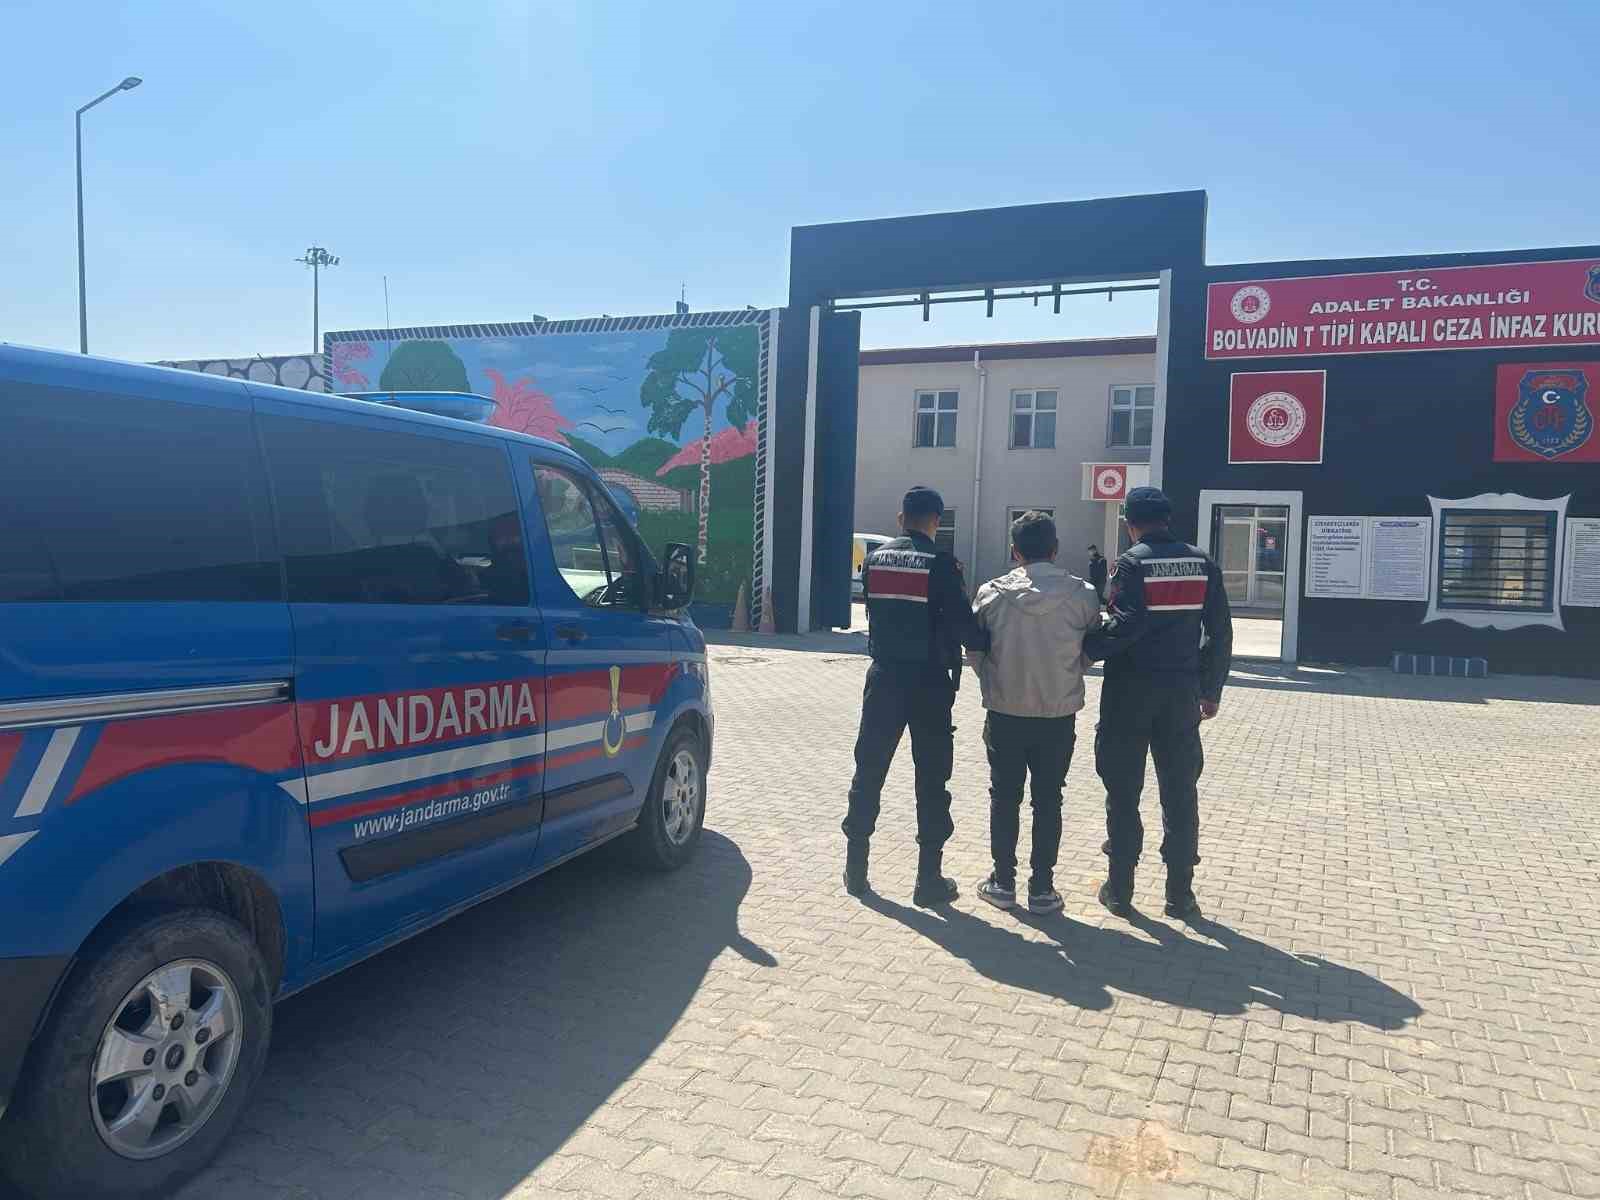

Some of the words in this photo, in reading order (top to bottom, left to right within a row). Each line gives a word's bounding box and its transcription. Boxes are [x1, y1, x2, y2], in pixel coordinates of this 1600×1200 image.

[1397, 278, 1438, 291] T.C.
[1310, 298, 1394, 314] ADALET
[1401, 288, 1530, 309] BAKANLIĞI
[1213, 322, 1298, 350] BOLVADİN
[1304, 326, 1314, 347] T
[1320, 319, 1354, 346] TİPİ
[1360, 319, 1427, 345] KAPALI
[1433, 317, 1483, 342] CEZA
[1489, 311, 1547, 339] İNFAZ
[1151, 562, 1201, 577] JANDARMA
[314, 683, 537, 758] JANDARMA
[354, 783, 511, 839] www.jandarma.gov.tr
